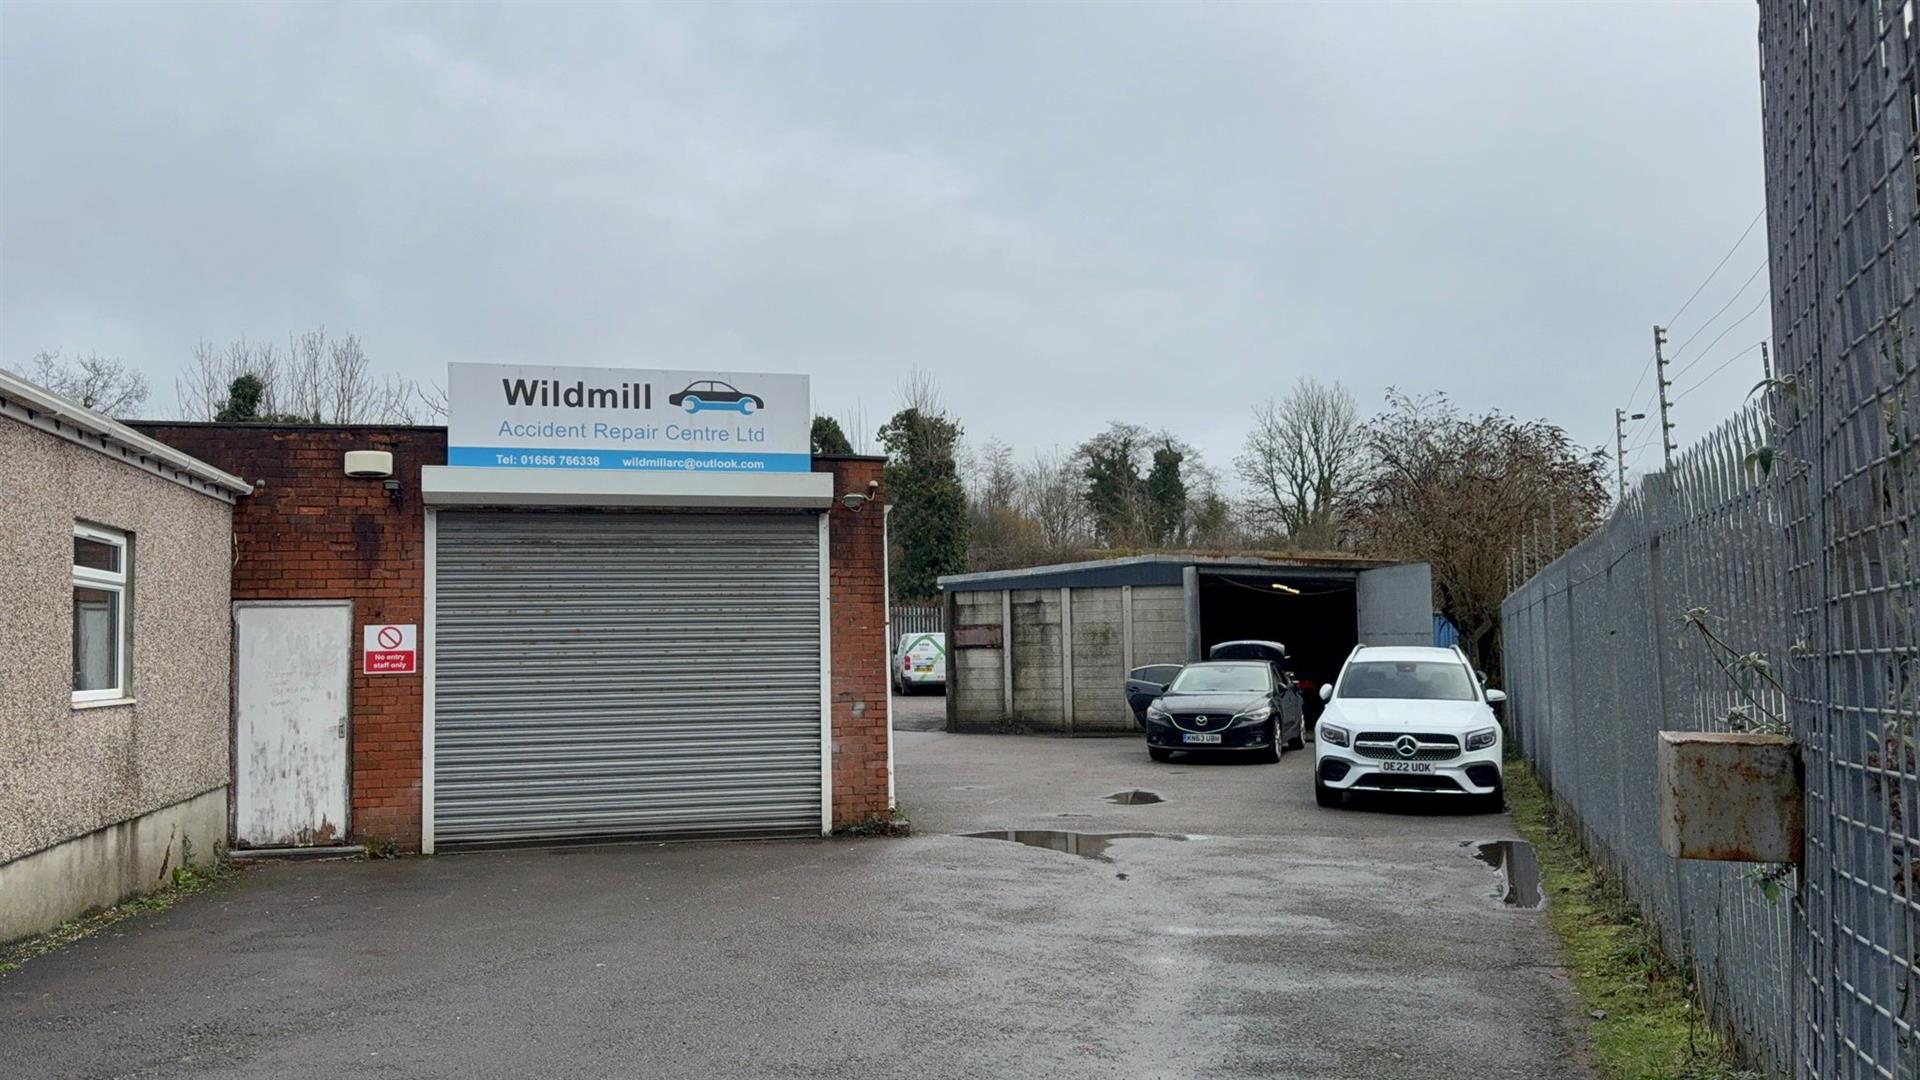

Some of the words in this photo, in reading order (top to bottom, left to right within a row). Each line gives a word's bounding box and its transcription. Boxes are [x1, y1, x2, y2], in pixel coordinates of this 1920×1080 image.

[502, 378, 652, 409] Wildmill
[498, 420, 587, 439] Accident
[594, 422, 659, 443] Repair
[665, 424, 729, 442] Centre
[736, 426, 765, 442] Ltd
[496, 454, 517, 465] Tel:
[520, 455, 556, 466] 01656
[559, 456, 600, 467] 766338
[622, 457, 765, 470] wildmillarc@outlook.com
[1383, 761, 1410, 771] OE22
